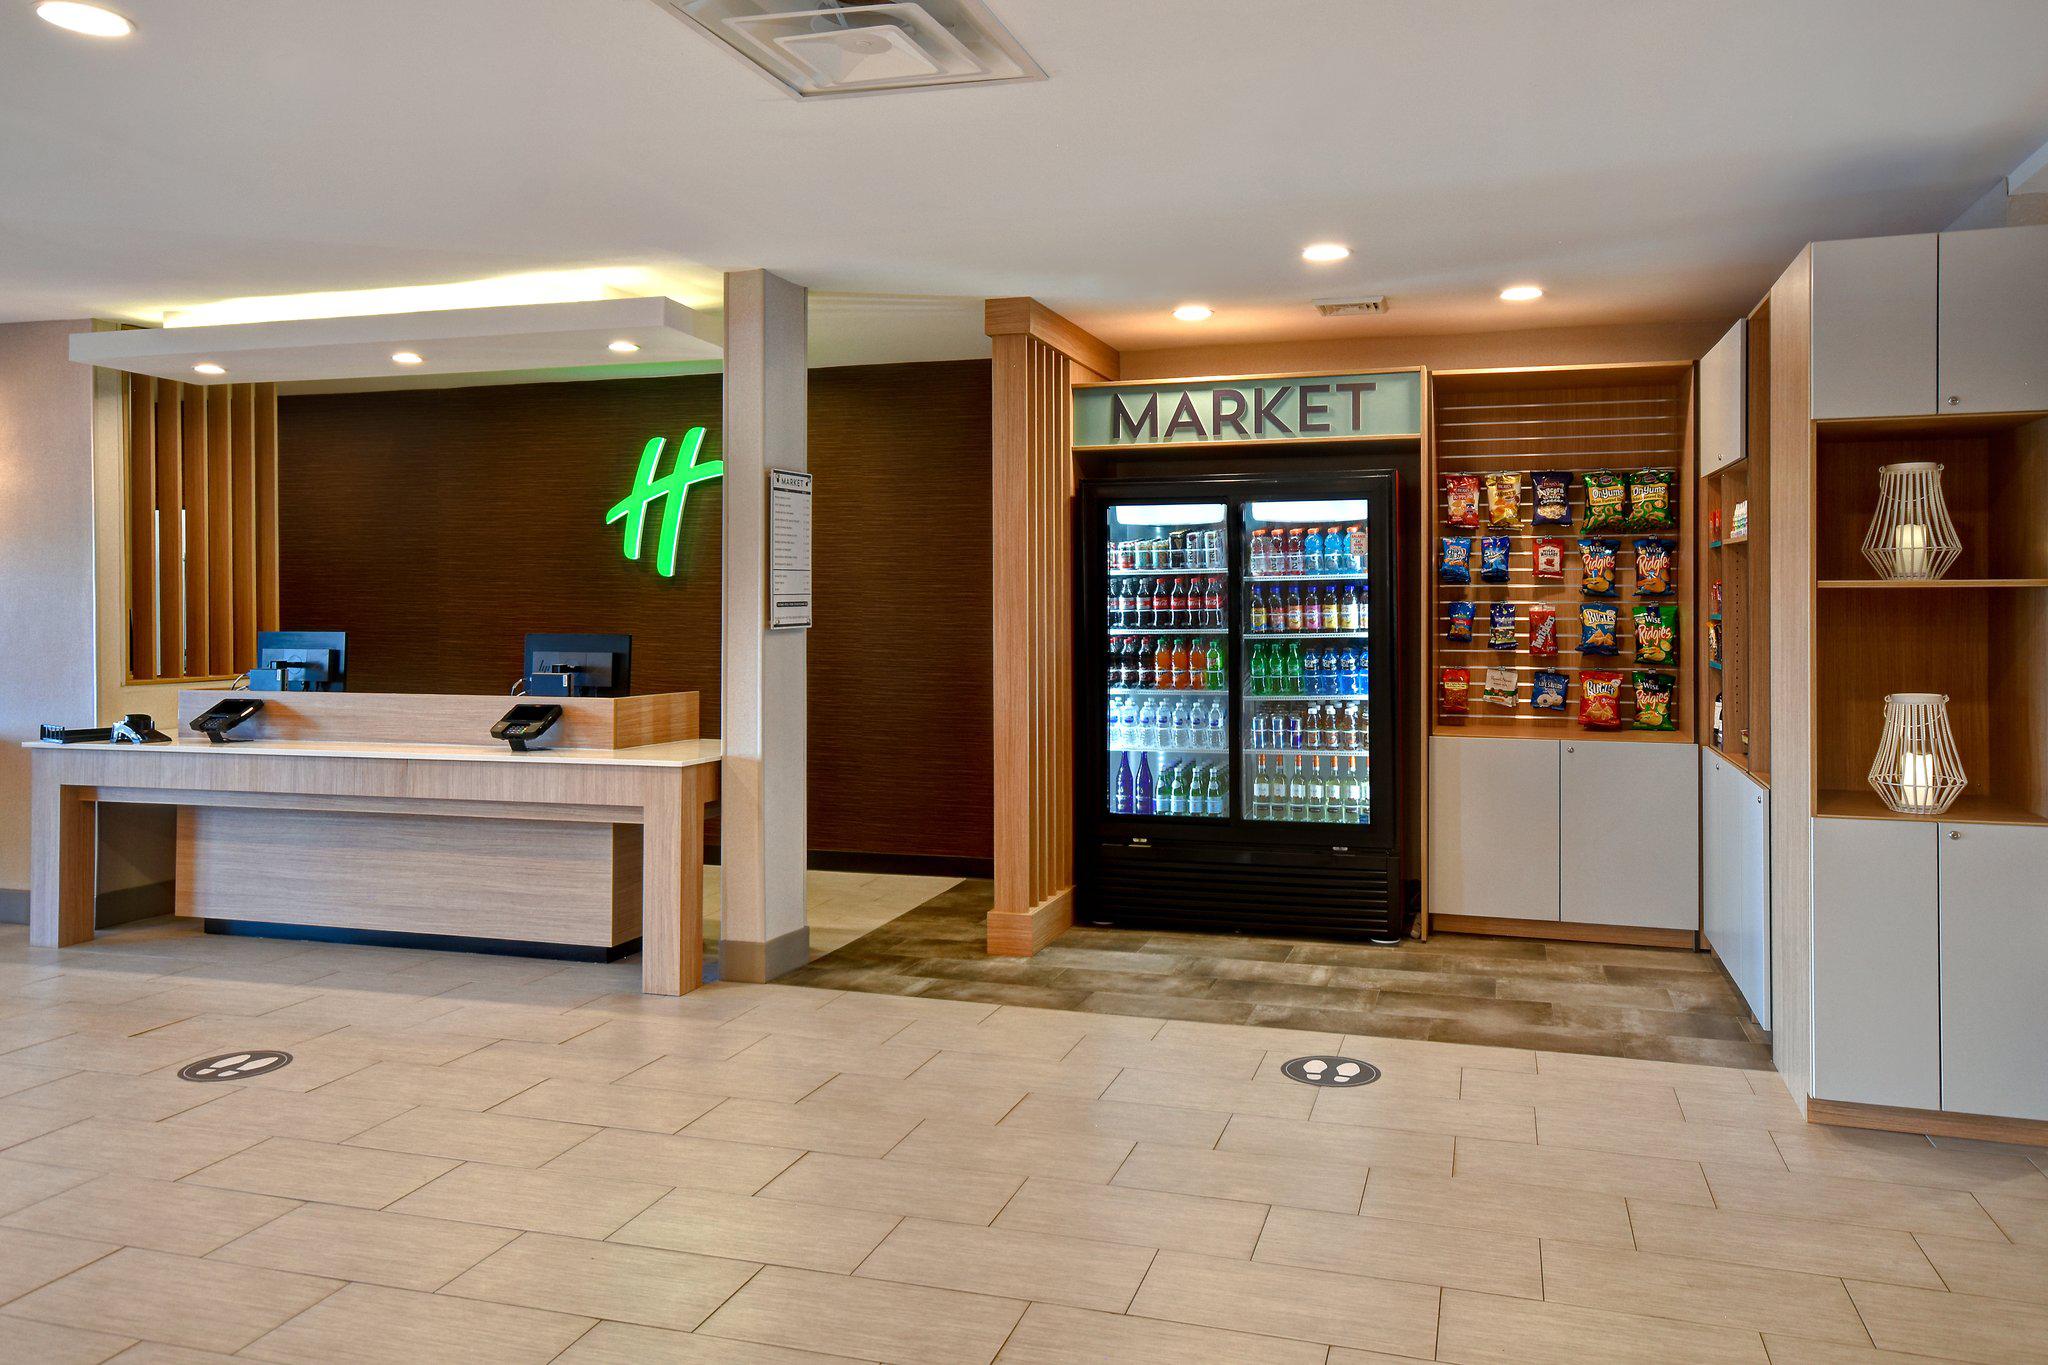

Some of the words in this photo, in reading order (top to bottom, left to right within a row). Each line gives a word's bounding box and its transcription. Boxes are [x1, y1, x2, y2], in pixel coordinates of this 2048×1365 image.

[1112, 382, 1377, 440] MARKET
[781, 477, 804, 487] MARKET
[1582, 554, 1615, 575] Ridgies
[1587, 610, 1615, 624] BUGLES
[1637, 624, 1673, 646] Ridgies
[1636, 690, 1670, 709] Ridgies
